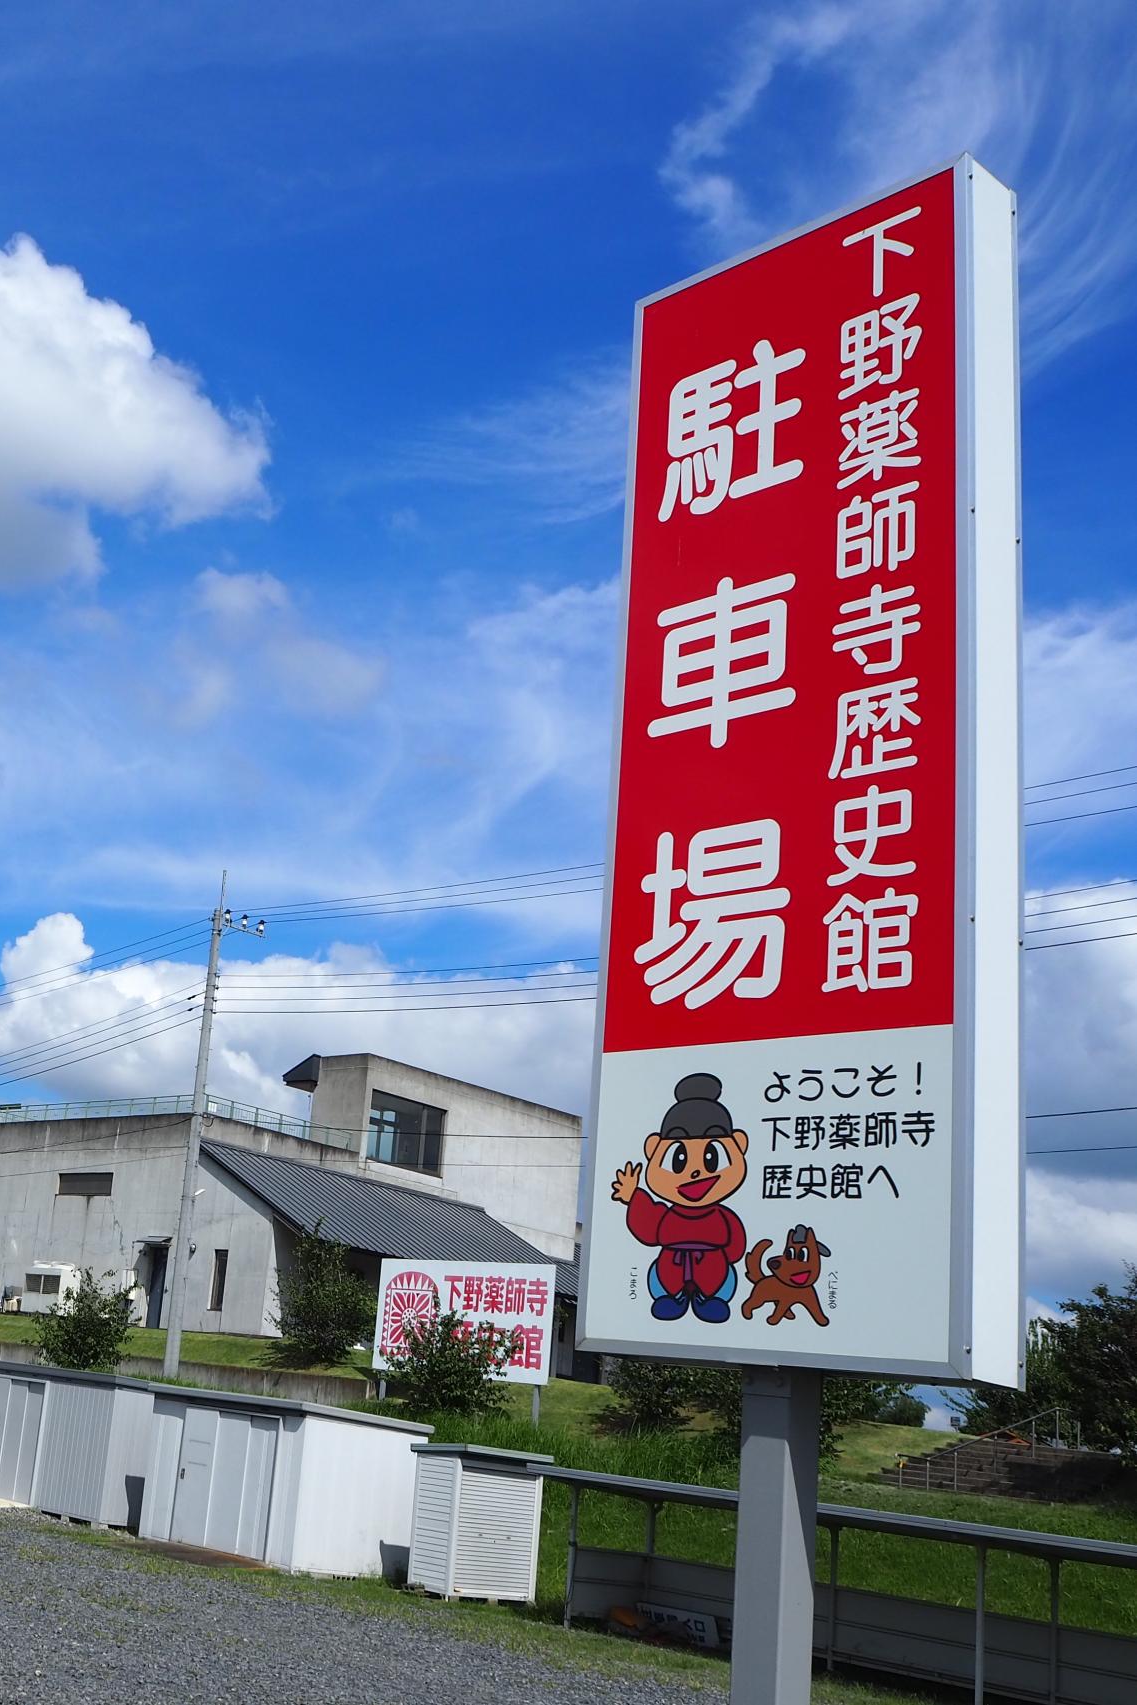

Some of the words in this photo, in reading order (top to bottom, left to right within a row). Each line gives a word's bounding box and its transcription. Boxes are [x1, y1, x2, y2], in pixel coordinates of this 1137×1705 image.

[822, 205, 923, 993] 下野薬師寺歴史館
[635, 339, 807, 1010] 駐車場
[764, 1061, 923, 1103] ようこそ！
[761, 1110, 936, 1151] 下野薬師寺
[761, 1163, 900, 1200] 歴史館へ
[444, 1275, 549, 1317] 下野薬師寺
